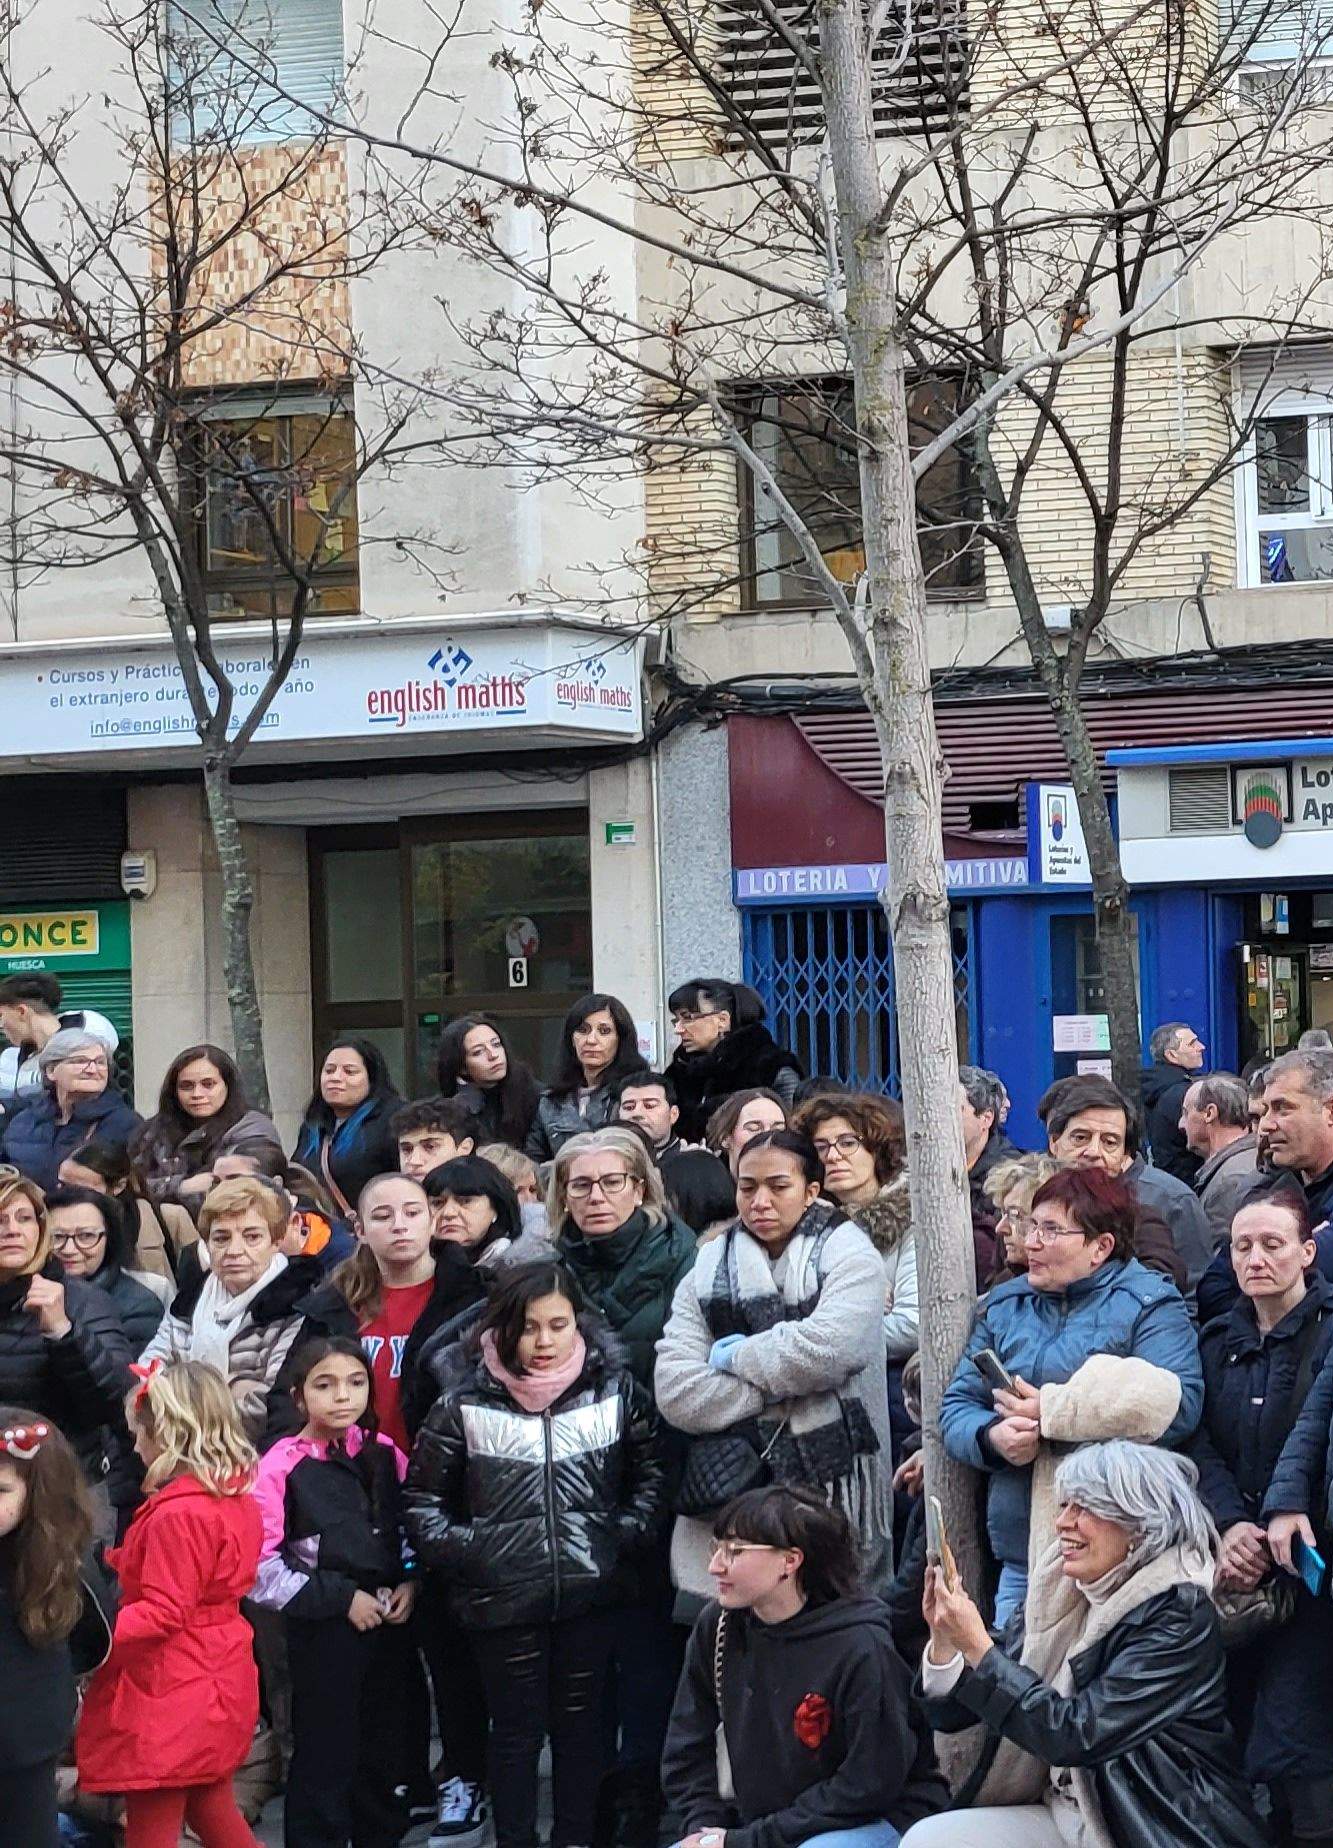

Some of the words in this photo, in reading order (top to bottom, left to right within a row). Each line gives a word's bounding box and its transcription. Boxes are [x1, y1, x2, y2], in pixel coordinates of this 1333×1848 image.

[49, 669, 105, 684] Cursos
[110, 669, 119, 684] y
[125, 663, 181, 680] Práctic
[50, 695, 63, 708] el
[69, 689, 150, 708] extranjero
[155, 686, 217, 702] durae
[232, 681, 259, 697] odo
[284, 678, 314, 694] año
[367, 680, 446, 727] english
[457, 676, 526, 709] maths
[556, 680, 595, 711] english
[600, 685, 632, 708] maths
[867, 867, 882, 889] Y
[944, 861, 1027, 885] MITIVA
[0, 920, 88, 948] ONCE
[8, 959, 46, 971] HUESCA
[512, 960, 524, 984] 6
